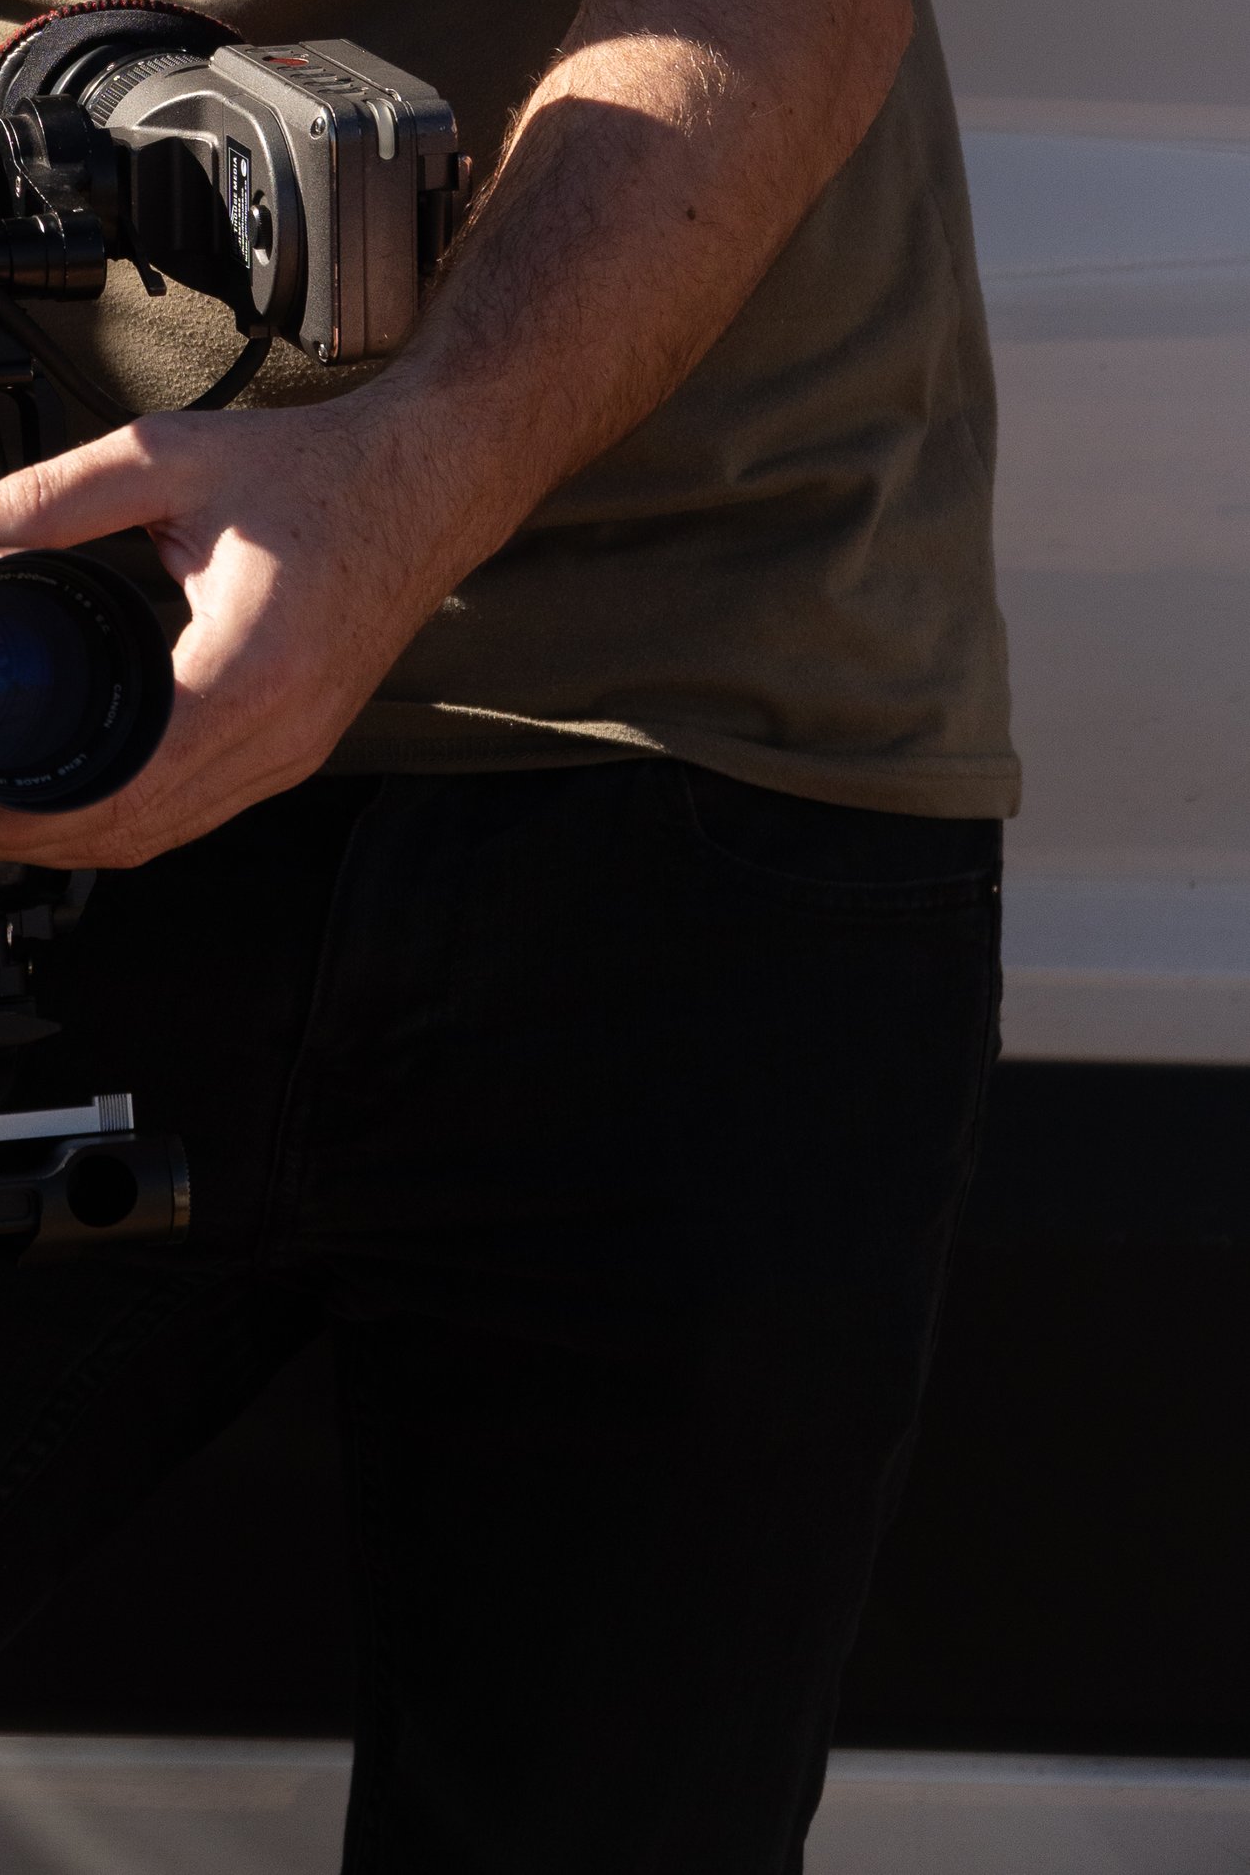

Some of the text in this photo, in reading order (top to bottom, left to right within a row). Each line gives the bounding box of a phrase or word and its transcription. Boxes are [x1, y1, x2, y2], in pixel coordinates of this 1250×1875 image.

[103, 682, 123, 730] CANON
[56, 752, 89, 776] LENS
[13, 774, 53, 788] MADE
